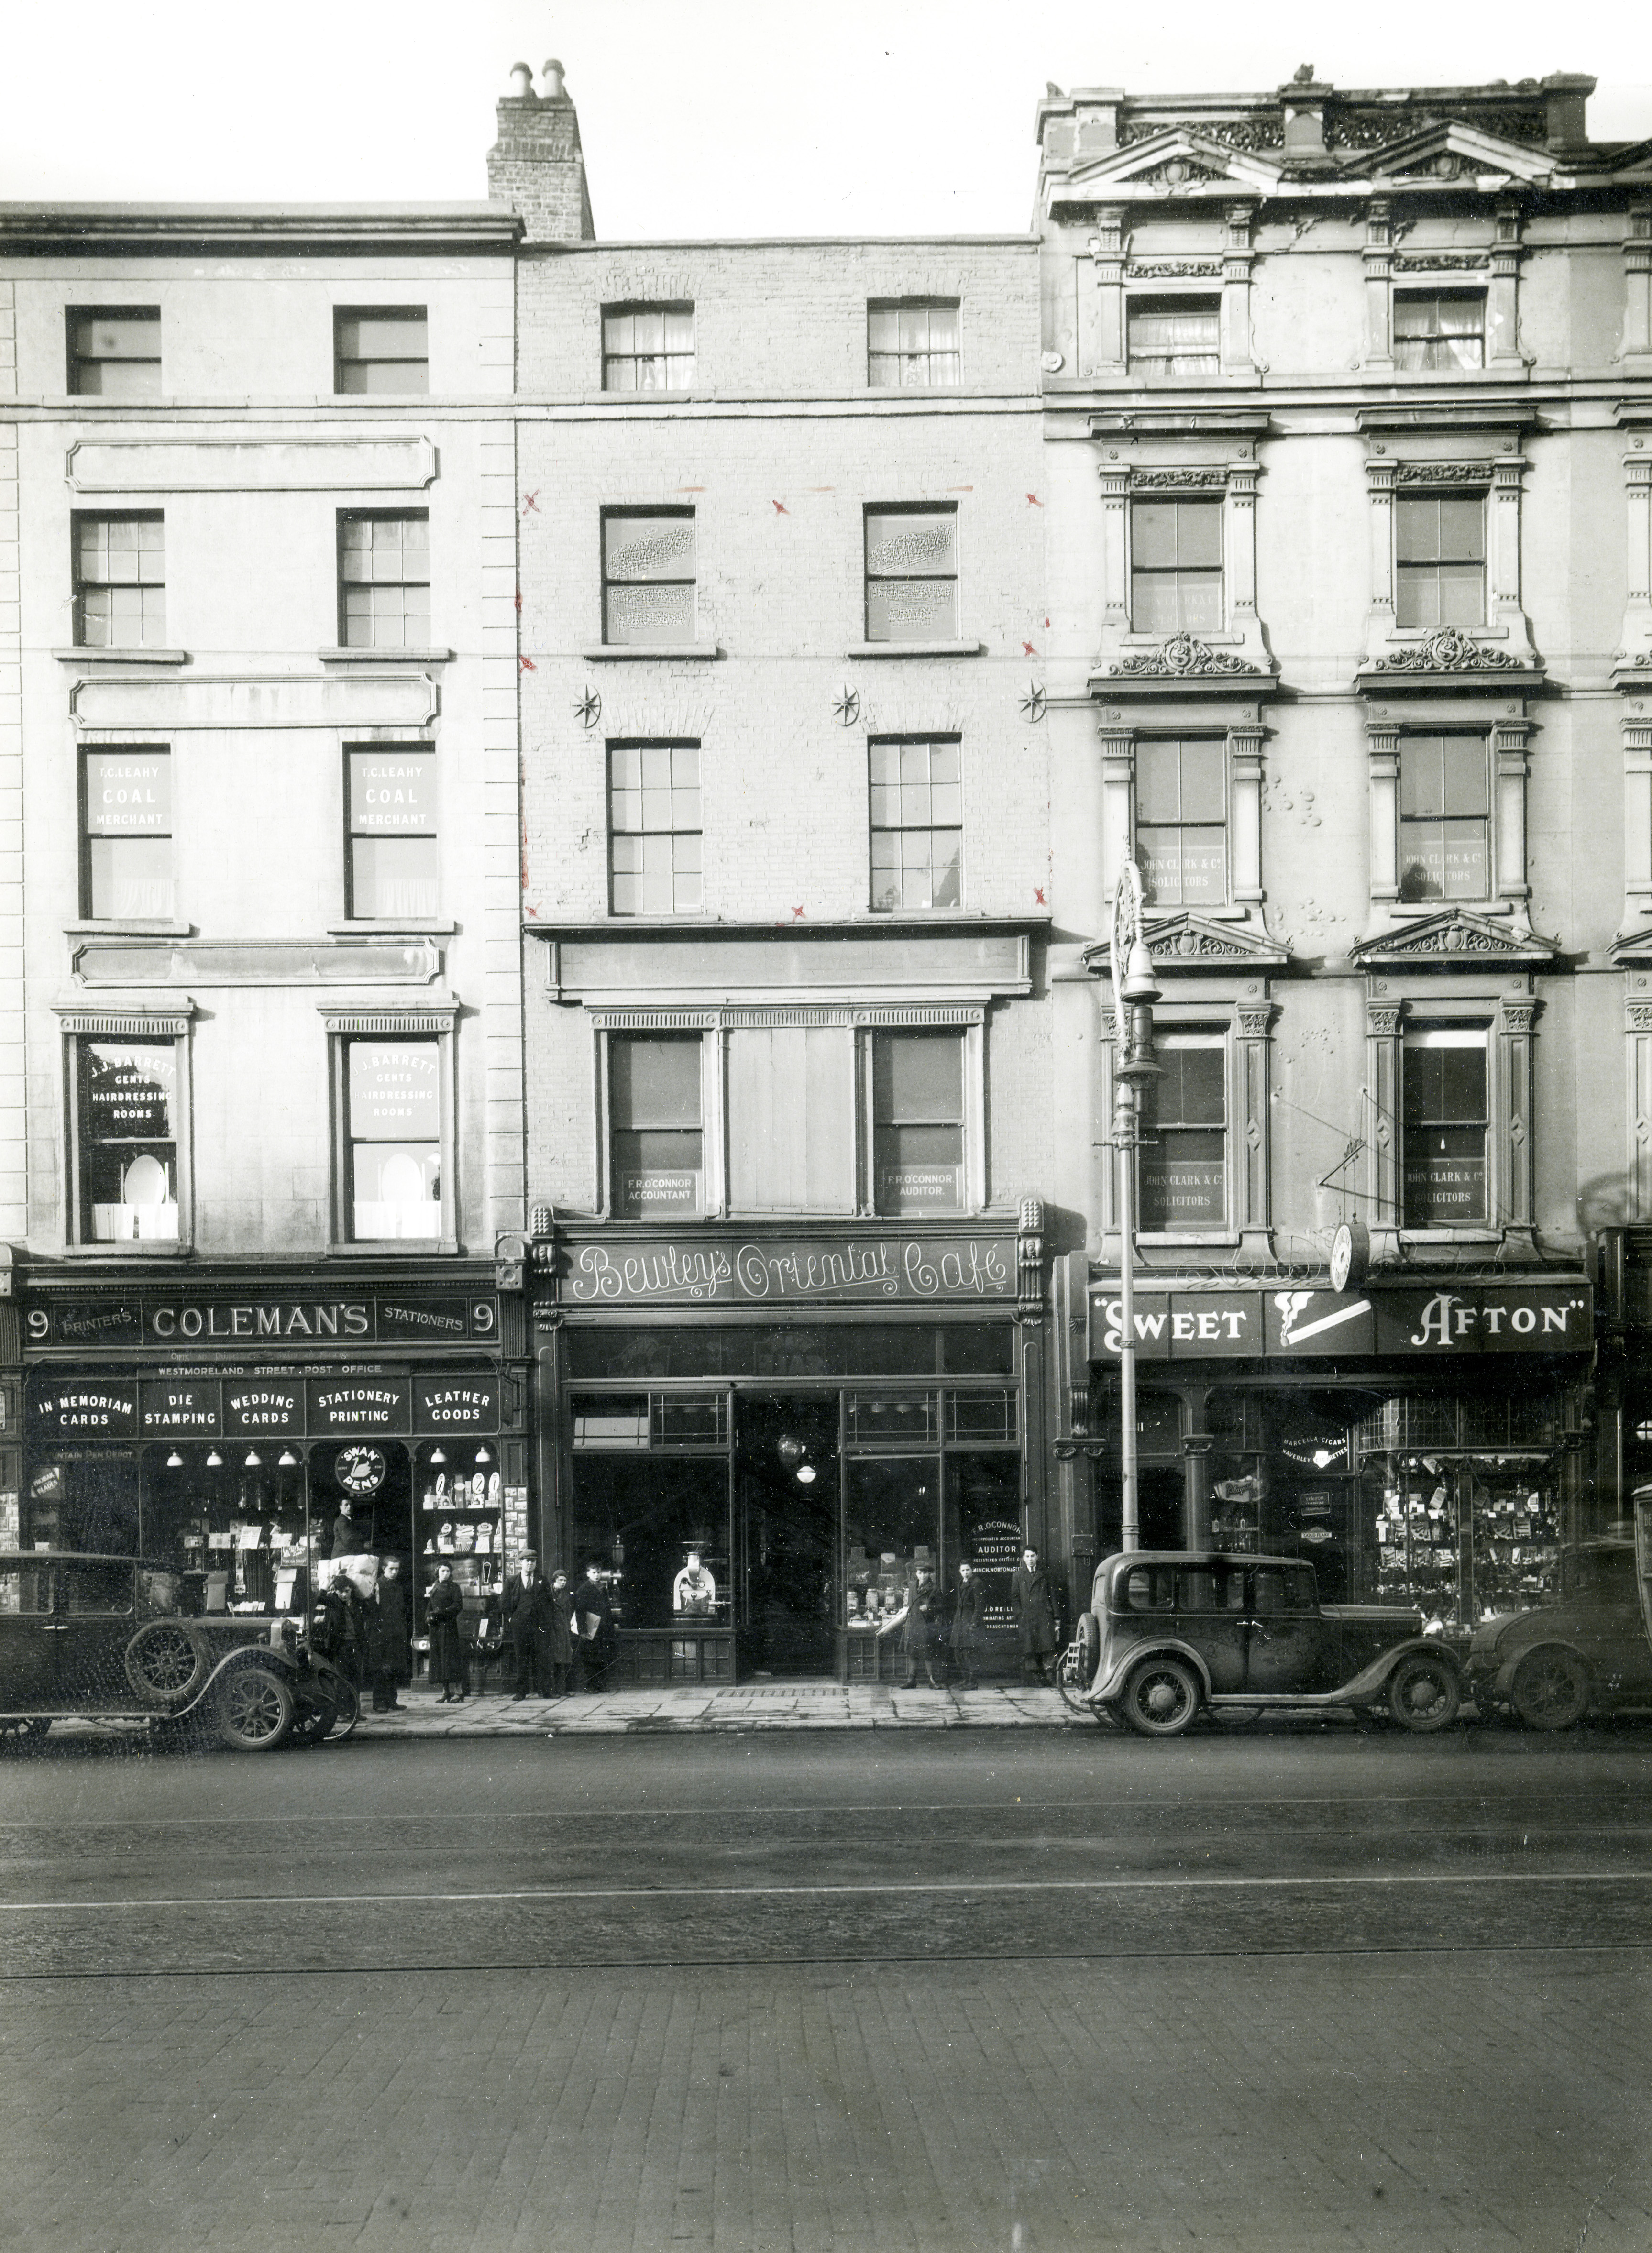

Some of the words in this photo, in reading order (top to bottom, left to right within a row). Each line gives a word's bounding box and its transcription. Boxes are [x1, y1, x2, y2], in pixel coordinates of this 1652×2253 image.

[103, 789, 155, 804] COAL
[366, 789, 418, 803] COAL
[96, 814, 162, 825] MERCHANT
[359, 814, 426, 825] MERCHANT
[1141, 860, 1164, 870] JOHN
[1167, 859, 1197, 869] CLRK
[1201, 859, 1209, 869] &
[1406, 854, 1425, 865] JOHN
[1463, 854, 1471, 863] &
[1151, 876, 1209, 888] SOLICTORS
[1415, 871, 1470, 882] SOLICTORS
[114, 1056, 176, 1077] BARRETT
[372, 1055, 436, 1075] BARRETT
[115, 1075, 150, 1084] GENTS
[376, 1073, 412, 1082] GENTS
[92, 1092, 172, 1101] HAIRDRESSING
[354, 1090, 433, 1099] HAIRDRESSING
[113, 1110, 152, 1119] ROOMS
[374, 1108, 413, 1116] ROOMS
[1144, 1175, 1167, 1186] JOHN
[1170, 1175, 1200, 1185] CLARK
[1204, 1175, 1211, 1185] &
[1407, 1173, 1426, 1182] JOHN
[1430, 1172, 1461, 1182] CLARK
[1464, 1172, 1471, 1181] &
[1154, 1196, 1210, 1206] SOLICITORS
[1414, 1192, 1471, 1202] SOLICITORS
[573, 1245, 731, 1299] Bewley's
[737, 1243, 896, 1297] Oriental
[904, 1241, 1006, 1294] Café
[27, 1309, 49, 1338] 9
[63, 1311, 132, 1335] PRINTERS
[153, 1303, 369, 1337] COLEMAN'S
[384, 1307, 463, 1331] STATIONERS
[473, 1303, 494, 1332] 9
[159, 1367, 244, 1376] WESTMORELAND
[254, 1366, 295, 1375] STREET
[305, 1365, 333, 1374] POST
[342, 1364, 382, 1374] OFFICE
[169, 1394, 193, 1406] DIE
[230, 1393, 294, 1410] WEDDING
[318, 1390, 400, 1407] STATIONERY
[425, 1390, 490, 1407] LEATHER
[39, 1403, 53, 1414] IN
[60, 1395, 132, 1415] MEMORIAM
[60, 1414, 109, 1425] CARDS
[145, 1413, 216, 1425] STAMPING
[242, 1412, 289, 1424] CARDS
[330, 1410, 388, 1422] PRINTING
[432, 1409, 480, 1421] GOODS
[1283, 1436, 1318, 1447] MARCELLA
[1321, 1437, 1346, 1446] CIGARS
[1282, 1448, 1311, 1463] WAVERLEY
[343, 1474, 379, 1491] PENS
[978, 1545, 1016, 1553] AUDITOR
